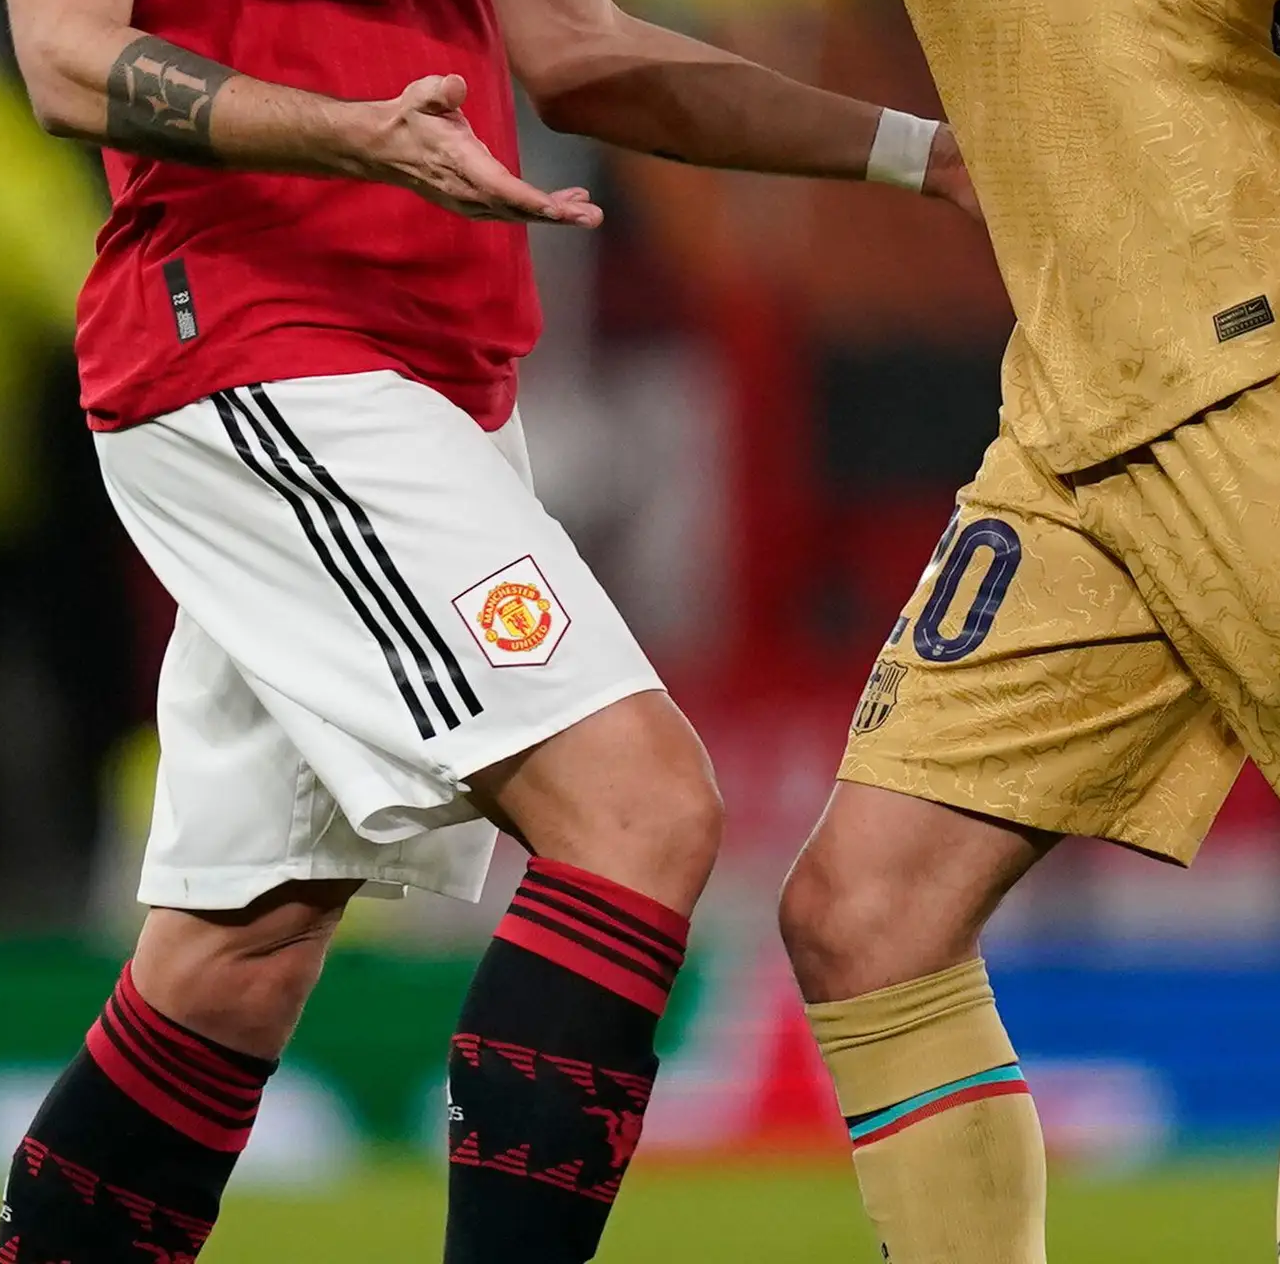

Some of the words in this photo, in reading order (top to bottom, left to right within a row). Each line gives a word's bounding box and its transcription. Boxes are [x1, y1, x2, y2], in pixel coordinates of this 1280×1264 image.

[888, 504, 1022, 663] 0
[483, 585, 538, 624] MANCHESTER
[510, 624, 549, 651] UNITED
